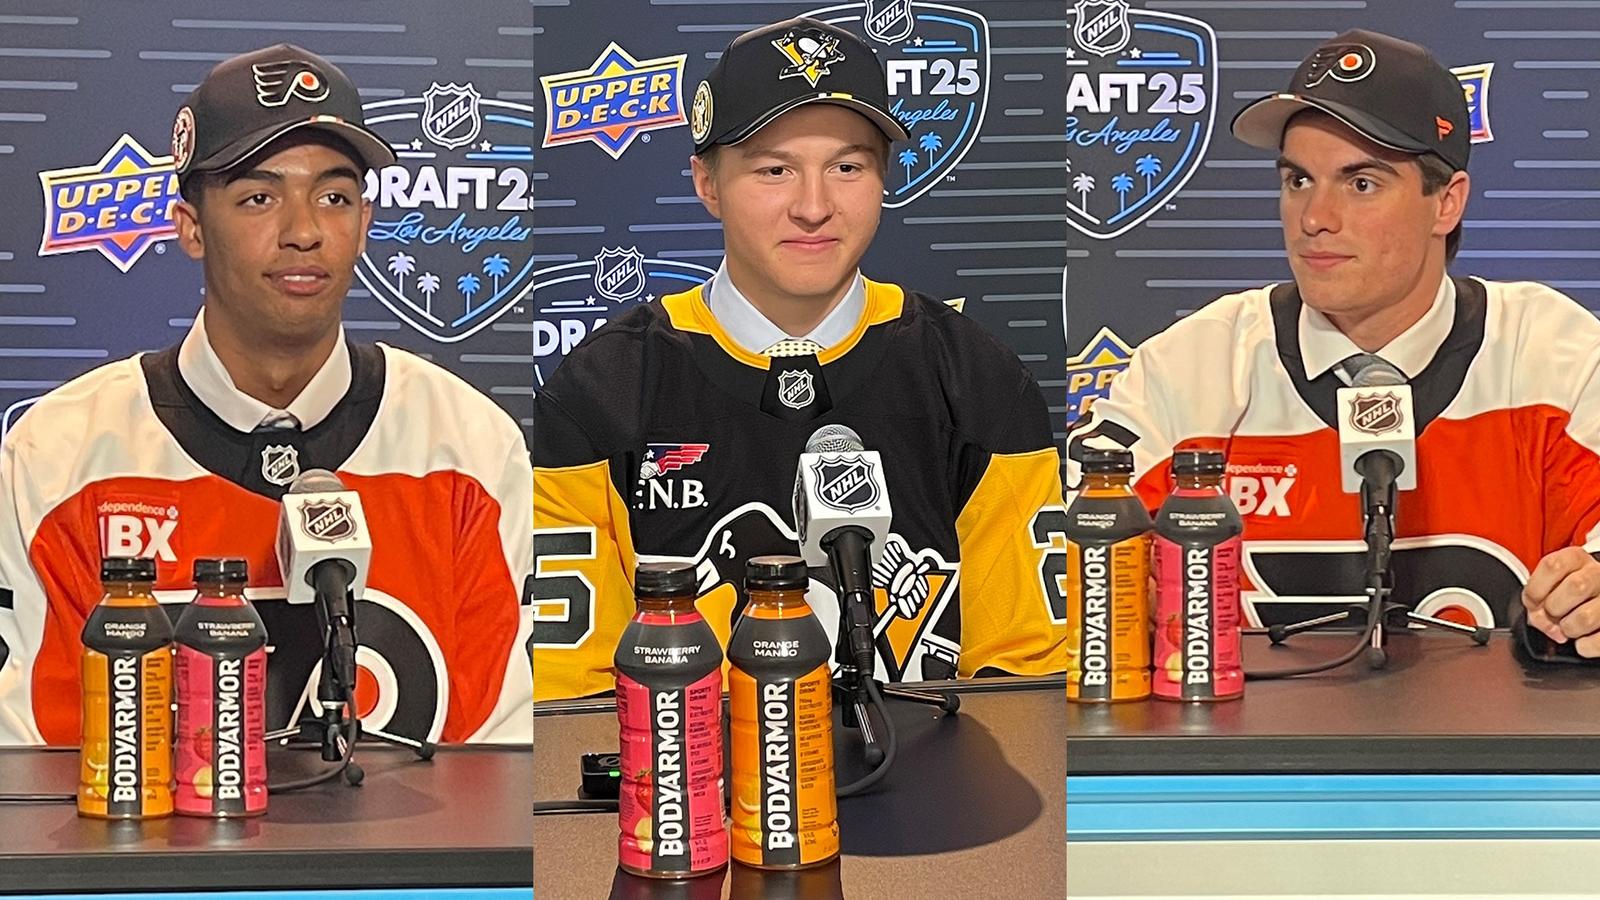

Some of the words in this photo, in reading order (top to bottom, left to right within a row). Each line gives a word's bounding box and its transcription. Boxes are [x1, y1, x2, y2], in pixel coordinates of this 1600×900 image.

[875, 6, 903, 32] NHL
[1087, 14, 1119, 42] NHL
[556, 73, 672, 107] UPPER
[887, 58, 980, 95] FT25
[1067, 73, 1206, 114] AFT25
[436, 103, 469, 134] NHL
[1076, 116, 1180, 153] Angeles
[368, 212, 424, 244] Los
[422, 212, 531, 253] Angeles
[606, 261, 636, 290] NHL
[787, 380, 807, 400] NHL
[1362, 402, 1391, 426] NHL
[271, 457, 292, 476] NHL
[829, 470, 864, 501] NHL
[1222, 476, 1296, 516] BX
[98, 501, 165, 516] dependence
[313, 510, 342, 533] NHL
[1084, 546, 1106, 686] BODYARMOR
[1187, 548, 1209, 685] BODYARMOR
[753, 640, 800, 649] ORANGE
[113, 656, 136, 802] BODYARMOR
[218, 659, 240, 800] BODYARMOR
[656, 690, 684, 857] BODYARMOR
[764, 683, 792, 851] BODYARMOR
